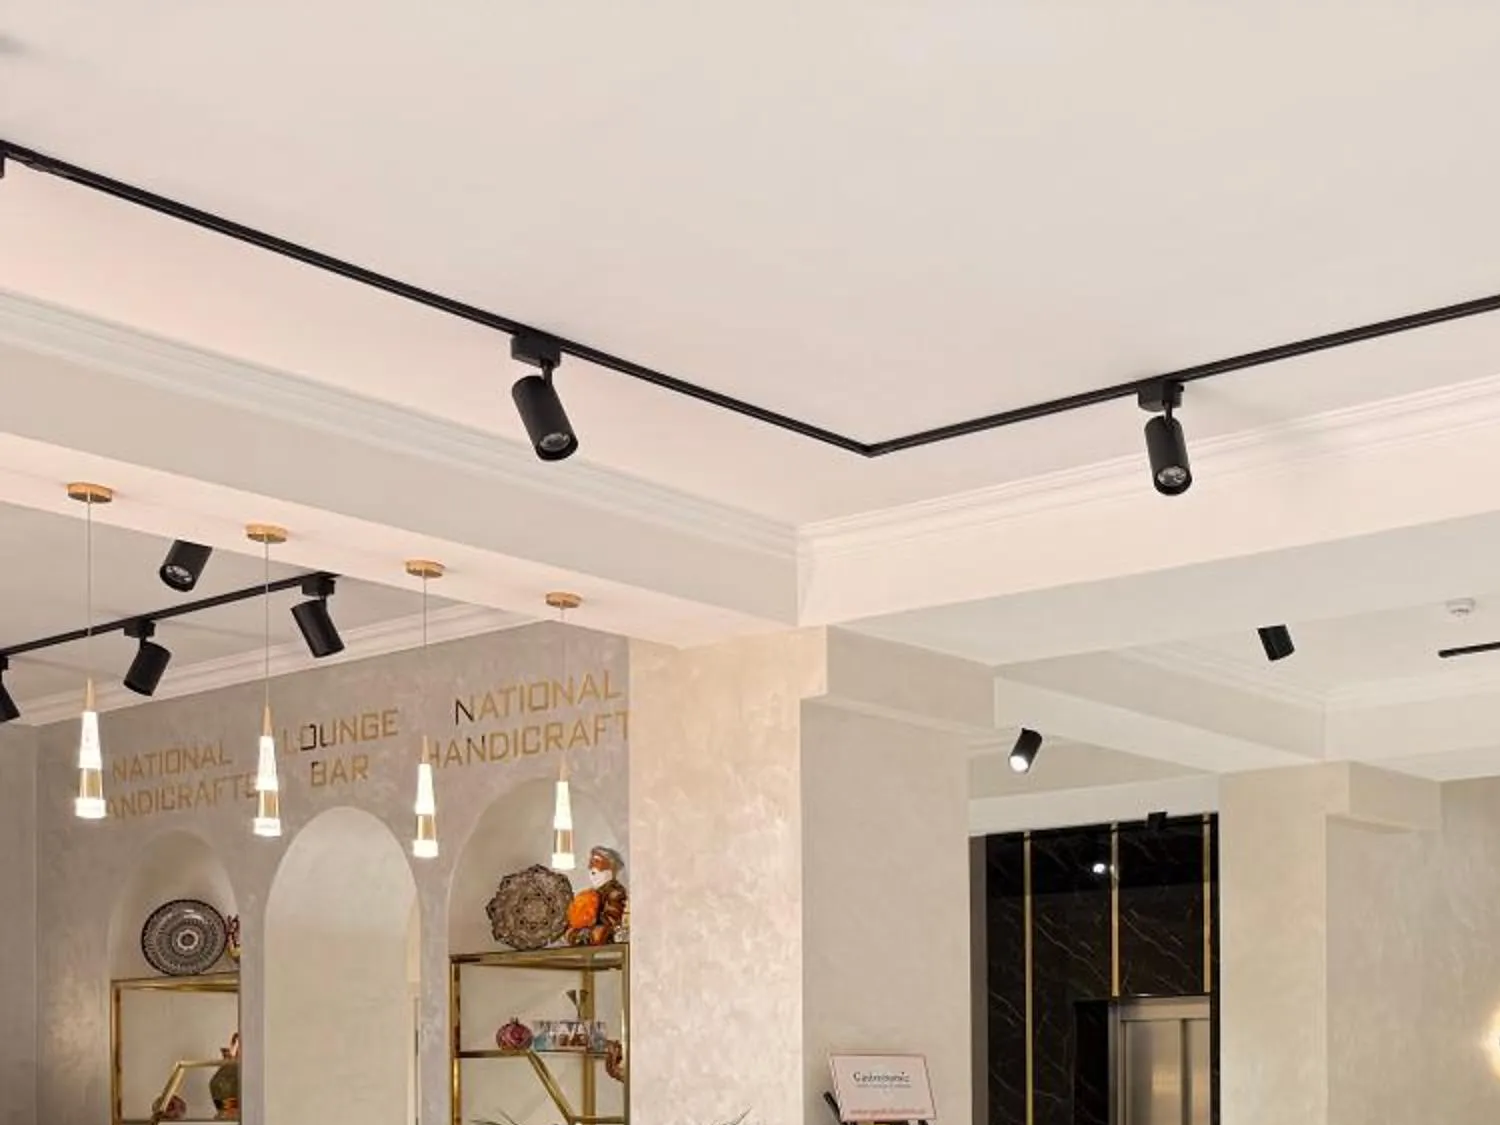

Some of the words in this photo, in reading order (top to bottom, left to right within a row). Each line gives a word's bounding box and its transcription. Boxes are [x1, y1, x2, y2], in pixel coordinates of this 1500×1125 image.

[454, 669, 623, 726] NATIONAL
[283, 709, 399, 755] LOUNGE
[112, 739, 233, 784] NATIONAL
[311, 754, 369, 788] BAR
[106, 773, 258, 820] ANDICRAFTS
